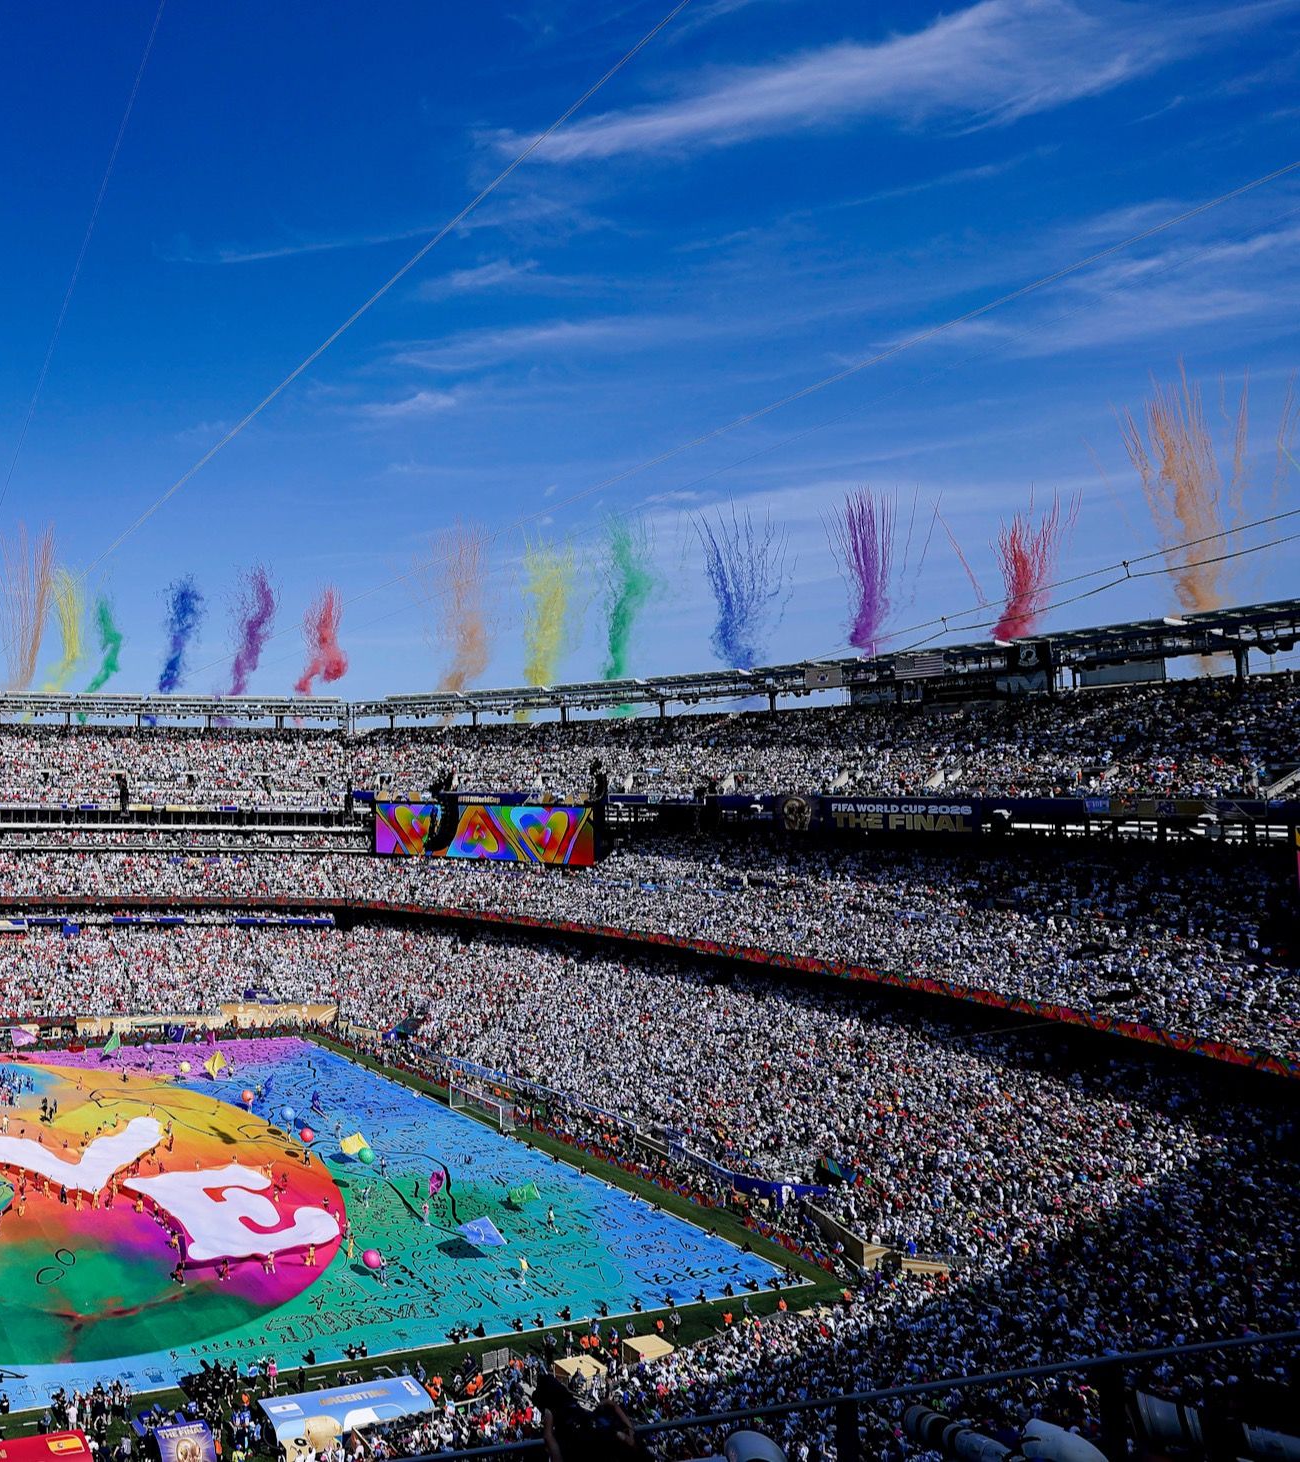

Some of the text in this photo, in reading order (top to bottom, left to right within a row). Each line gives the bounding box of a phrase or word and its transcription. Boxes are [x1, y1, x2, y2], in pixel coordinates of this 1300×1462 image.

[831, 803, 973, 815] FIFA WORLD CUP 2026
[832, 813, 973, 832] THE FINAL
[319, 1387, 392, 1406] ARGENTINA
[161, 1431, 179, 1440] THE
[179, 1426, 206, 1438] FINAL
